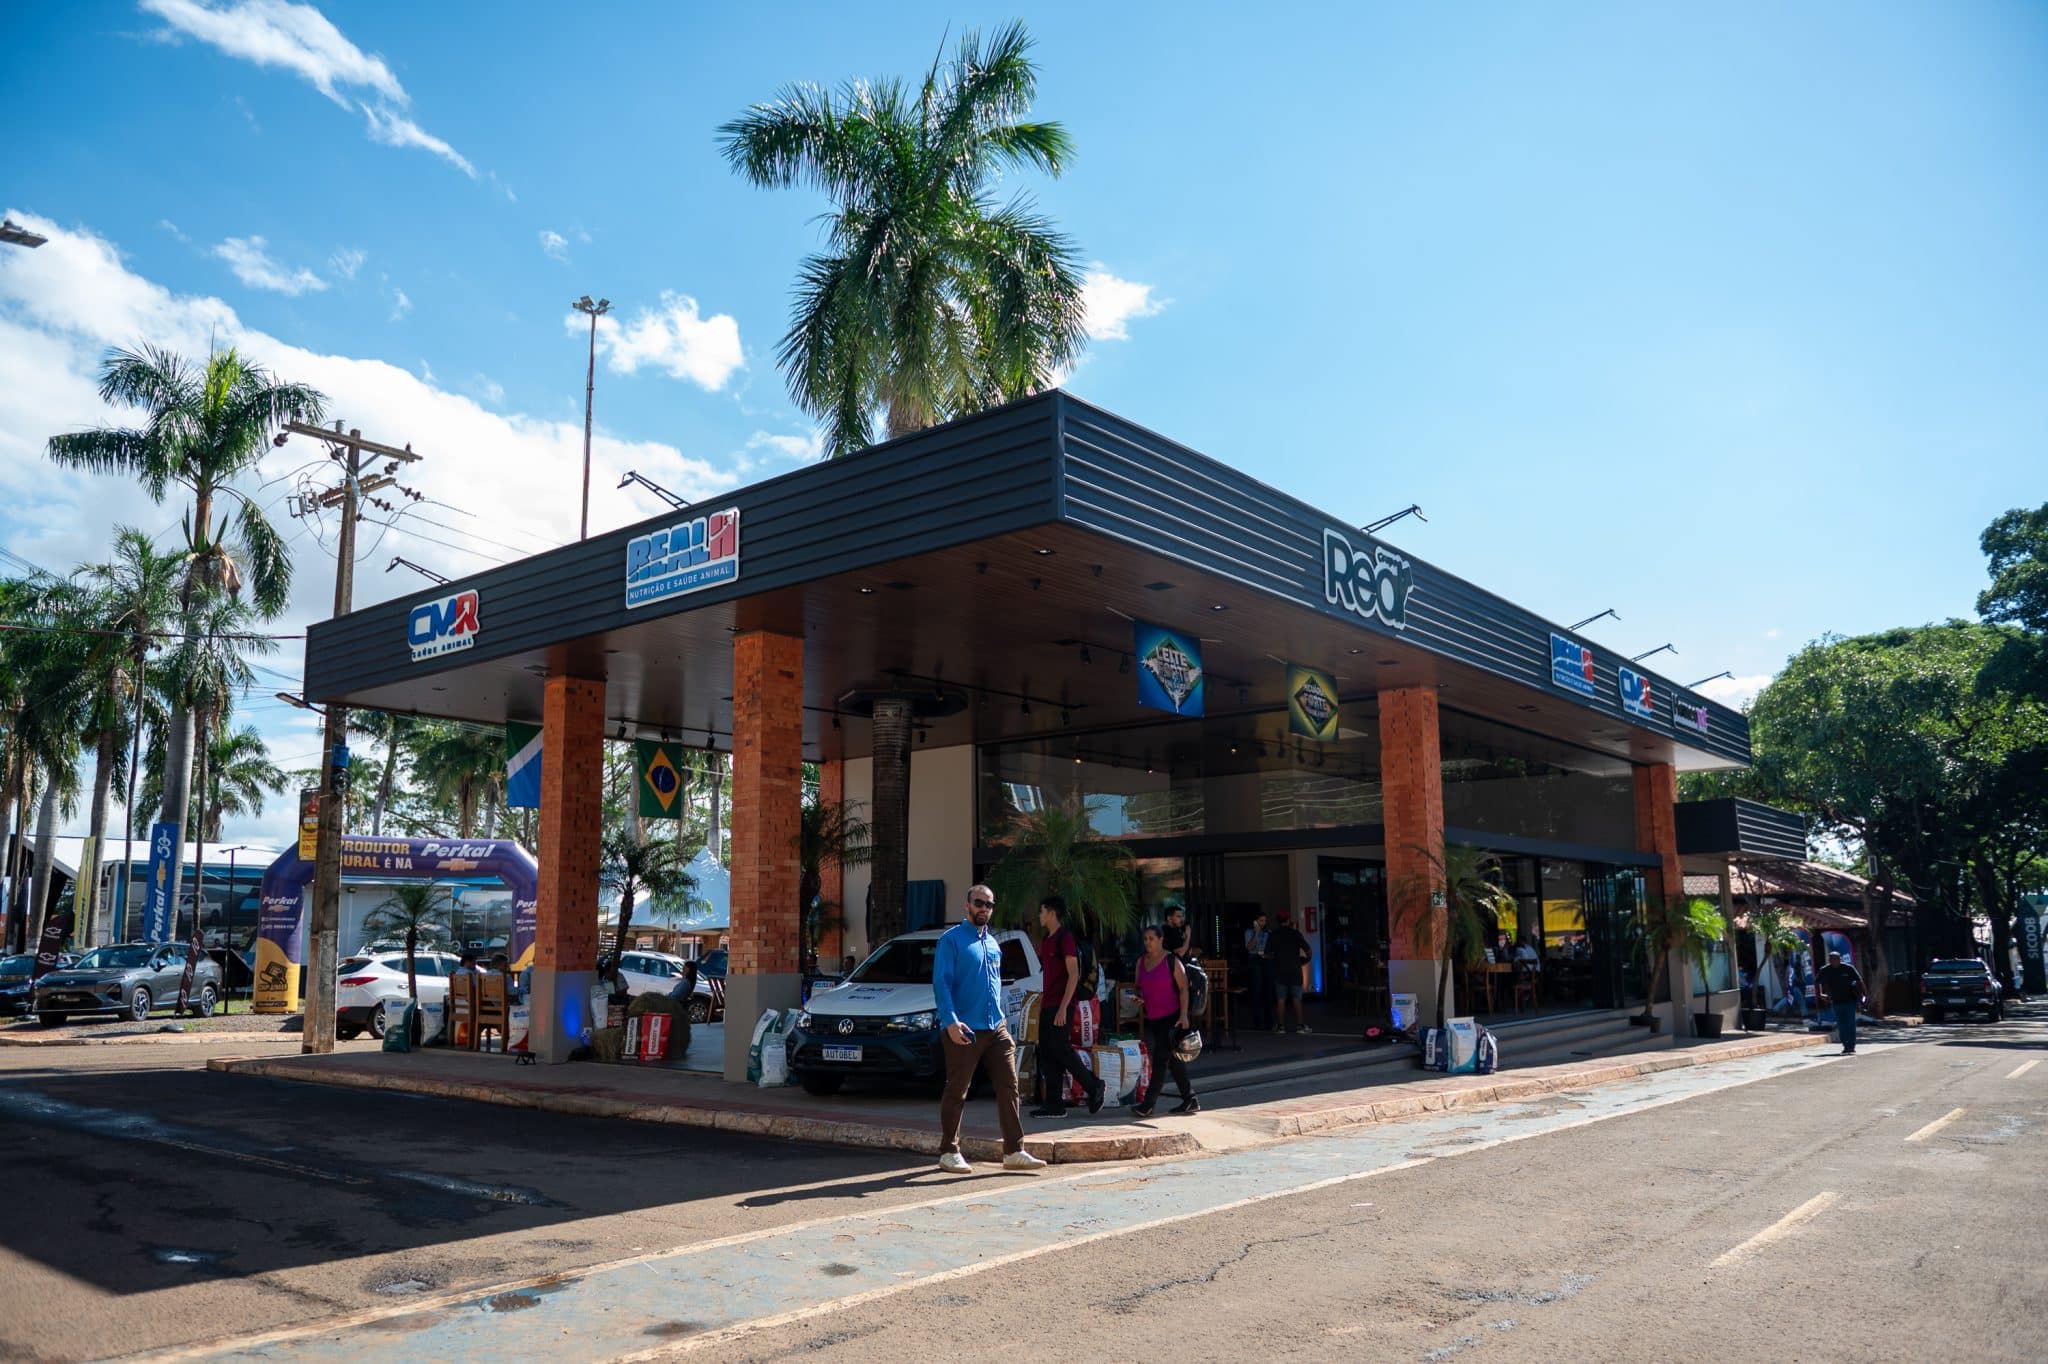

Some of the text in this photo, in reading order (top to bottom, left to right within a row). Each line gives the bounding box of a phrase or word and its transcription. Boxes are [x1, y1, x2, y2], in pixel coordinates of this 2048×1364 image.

[629, 566, 730, 600] NUTRIÇÃO E SAÚDE ANIMAL
[408, 592, 478, 646] CMR
[412, 638, 473, 659] SAÚDE ANIMAL
[1156, 646, 1188, 667] LEITE
[420, 842, 496, 858] Perkal
[384, 858, 392, 869] É
[395, 858, 413, 870] NA
[262, 896, 299, 906] Perkal
[151, 889, 166, 944] Perkal
[2024, 917, 2040, 960] SICOOB
